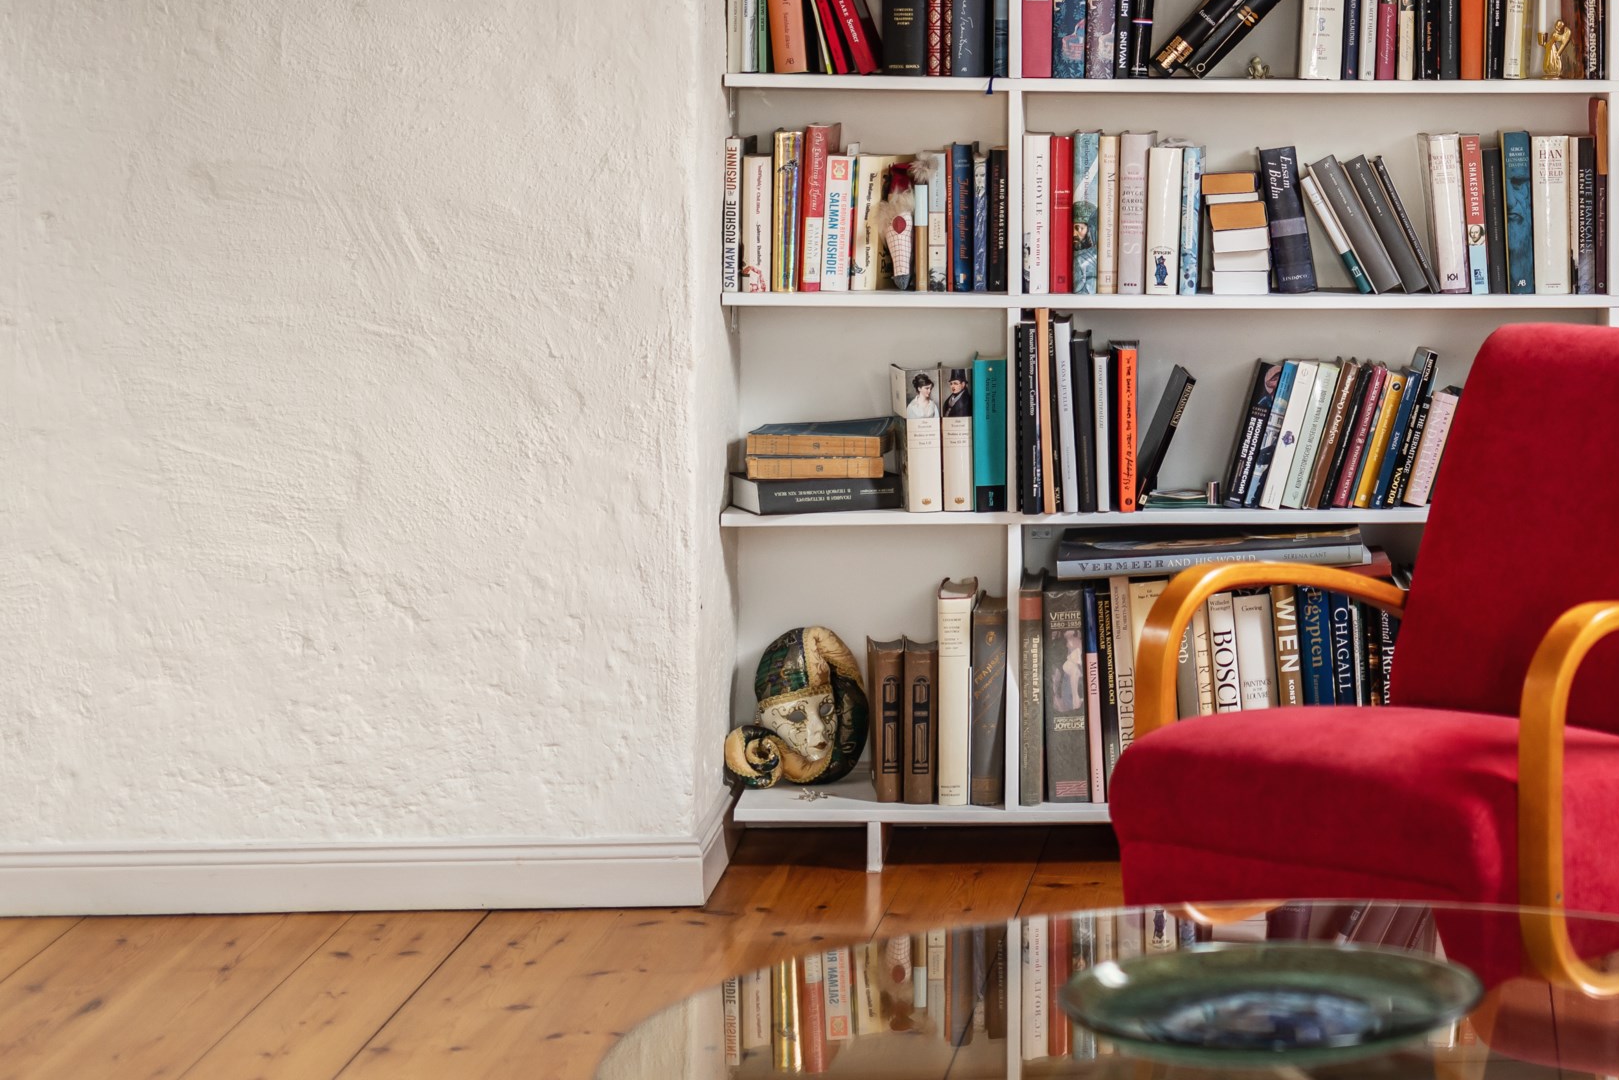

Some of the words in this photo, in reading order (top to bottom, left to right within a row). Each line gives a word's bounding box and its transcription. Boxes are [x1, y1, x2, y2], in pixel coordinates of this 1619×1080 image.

[846, 18, 860, 43] Sonetter
[1587, 0, 1596, 27] Singer
[1118, 31, 1128, 69] SNUVAN
[726, 146, 738, 190] URSINNE
[1268, 170, 1280, 199] Berlin
[1280, 156, 1292, 188] Ensam
[1584, 168, 1592, 198] SUITE
[1035, 177, 1044, 216] BOYLE
[1468, 162, 1479, 216] SHAKESPEARE
[725, 200, 737, 244] RUSHDIE
[828, 192, 840, 229] SALMAN
[1035, 221, 1043, 236] the
[1584, 200, 1593, 254] FRANÇAISE
[724, 247, 736, 288] SALMAN
[826, 234, 838, 275] RUSHDIE
[1028, 329, 1036, 353] Bernardo
[1418, 414, 1426, 429] THE
[1238, 418, 1263, 494] ИКОНОГРАФИЧЕСКИЙ
[1403, 431, 1421, 474] HERMITAGE
[1387, 467, 1404, 504] BOLOGNA
[1078, 561, 1165, 572] VERMEER
[1168, 559, 1191, 568] AND
[1098, 601, 1106, 649] INSPELNINGAR
[1104, 600, 1112, 636] KLASSISKA
[1275, 596, 1299, 673] WIEN
[1304, 591, 1323, 667] Egypten
[1105, 638, 1114, 688] KOMPOSITÖRER
[1333, 608, 1351, 694] CHAGALL
[1288, 679, 1296, 705] KONST
